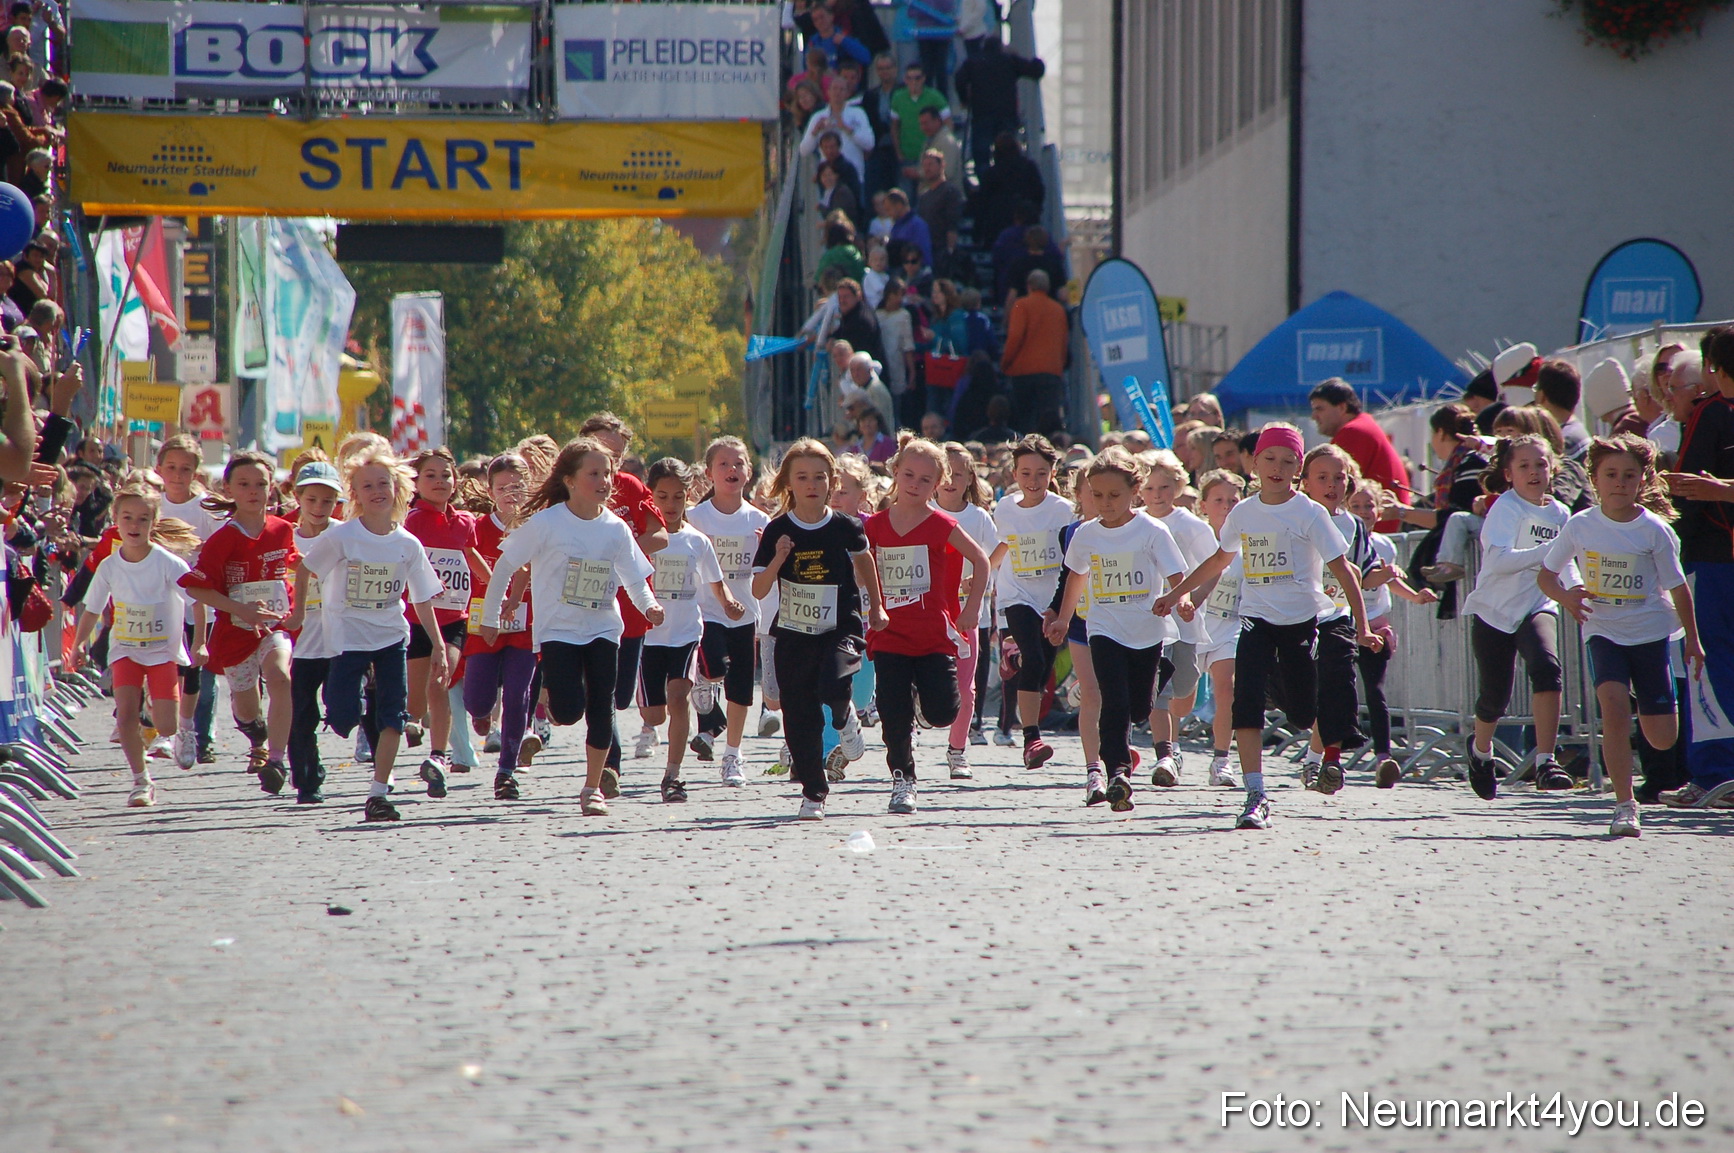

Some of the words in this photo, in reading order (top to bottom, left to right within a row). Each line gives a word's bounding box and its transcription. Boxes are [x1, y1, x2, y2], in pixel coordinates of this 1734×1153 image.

[176, 24, 439, 79] BOCK
[612, 39, 766, 66] PFLEIDERER
[612, 70, 767, 84] AKTIENGESELLSCHAFT
[107, 161, 190, 176] Neumarkter
[194, 164, 259, 178] Stadtlauf
[300, 138, 535, 190] START
[579, 169, 658, 181] Neumarkter
[663, 169, 725, 181] Stadtlauf
[1611, 286, 1667, 314] maxi
[1306, 338, 1363, 361] maxi
[716, 538, 738, 548] Celina
[1019, 537, 1036, 546] Julia
[1248, 536, 1269, 547] Sarah
[428, 551, 461, 566] Lena
[658, 556, 689, 567] Vanessa
[718, 552, 751, 565] 7185
[883, 551, 906, 561] Laura
[1021, 547, 1057, 563] 7145
[1250, 551, 1288, 567] 7125
[1601, 556, 1628, 568] Hanna
[363, 564, 388, 575] Sarah
[1101, 558, 1118, 568] Lisa
[660, 571, 693, 585] 7191
[886, 564, 924, 580] 7040
[1104, 570, 1144, 587] 7110
[364, 579, 401, 594] 7190
[582, 577, 616, 595] 7049
[1601, 573, 1644, 590] 7208
[245, 586, 271, 596] Sophie
[792, 587, 816, 599] Selina
[126, 607, 147, 617] Marie
[793, 602, 832, 620] 7087
[127, 619, 164, 633] 7115
